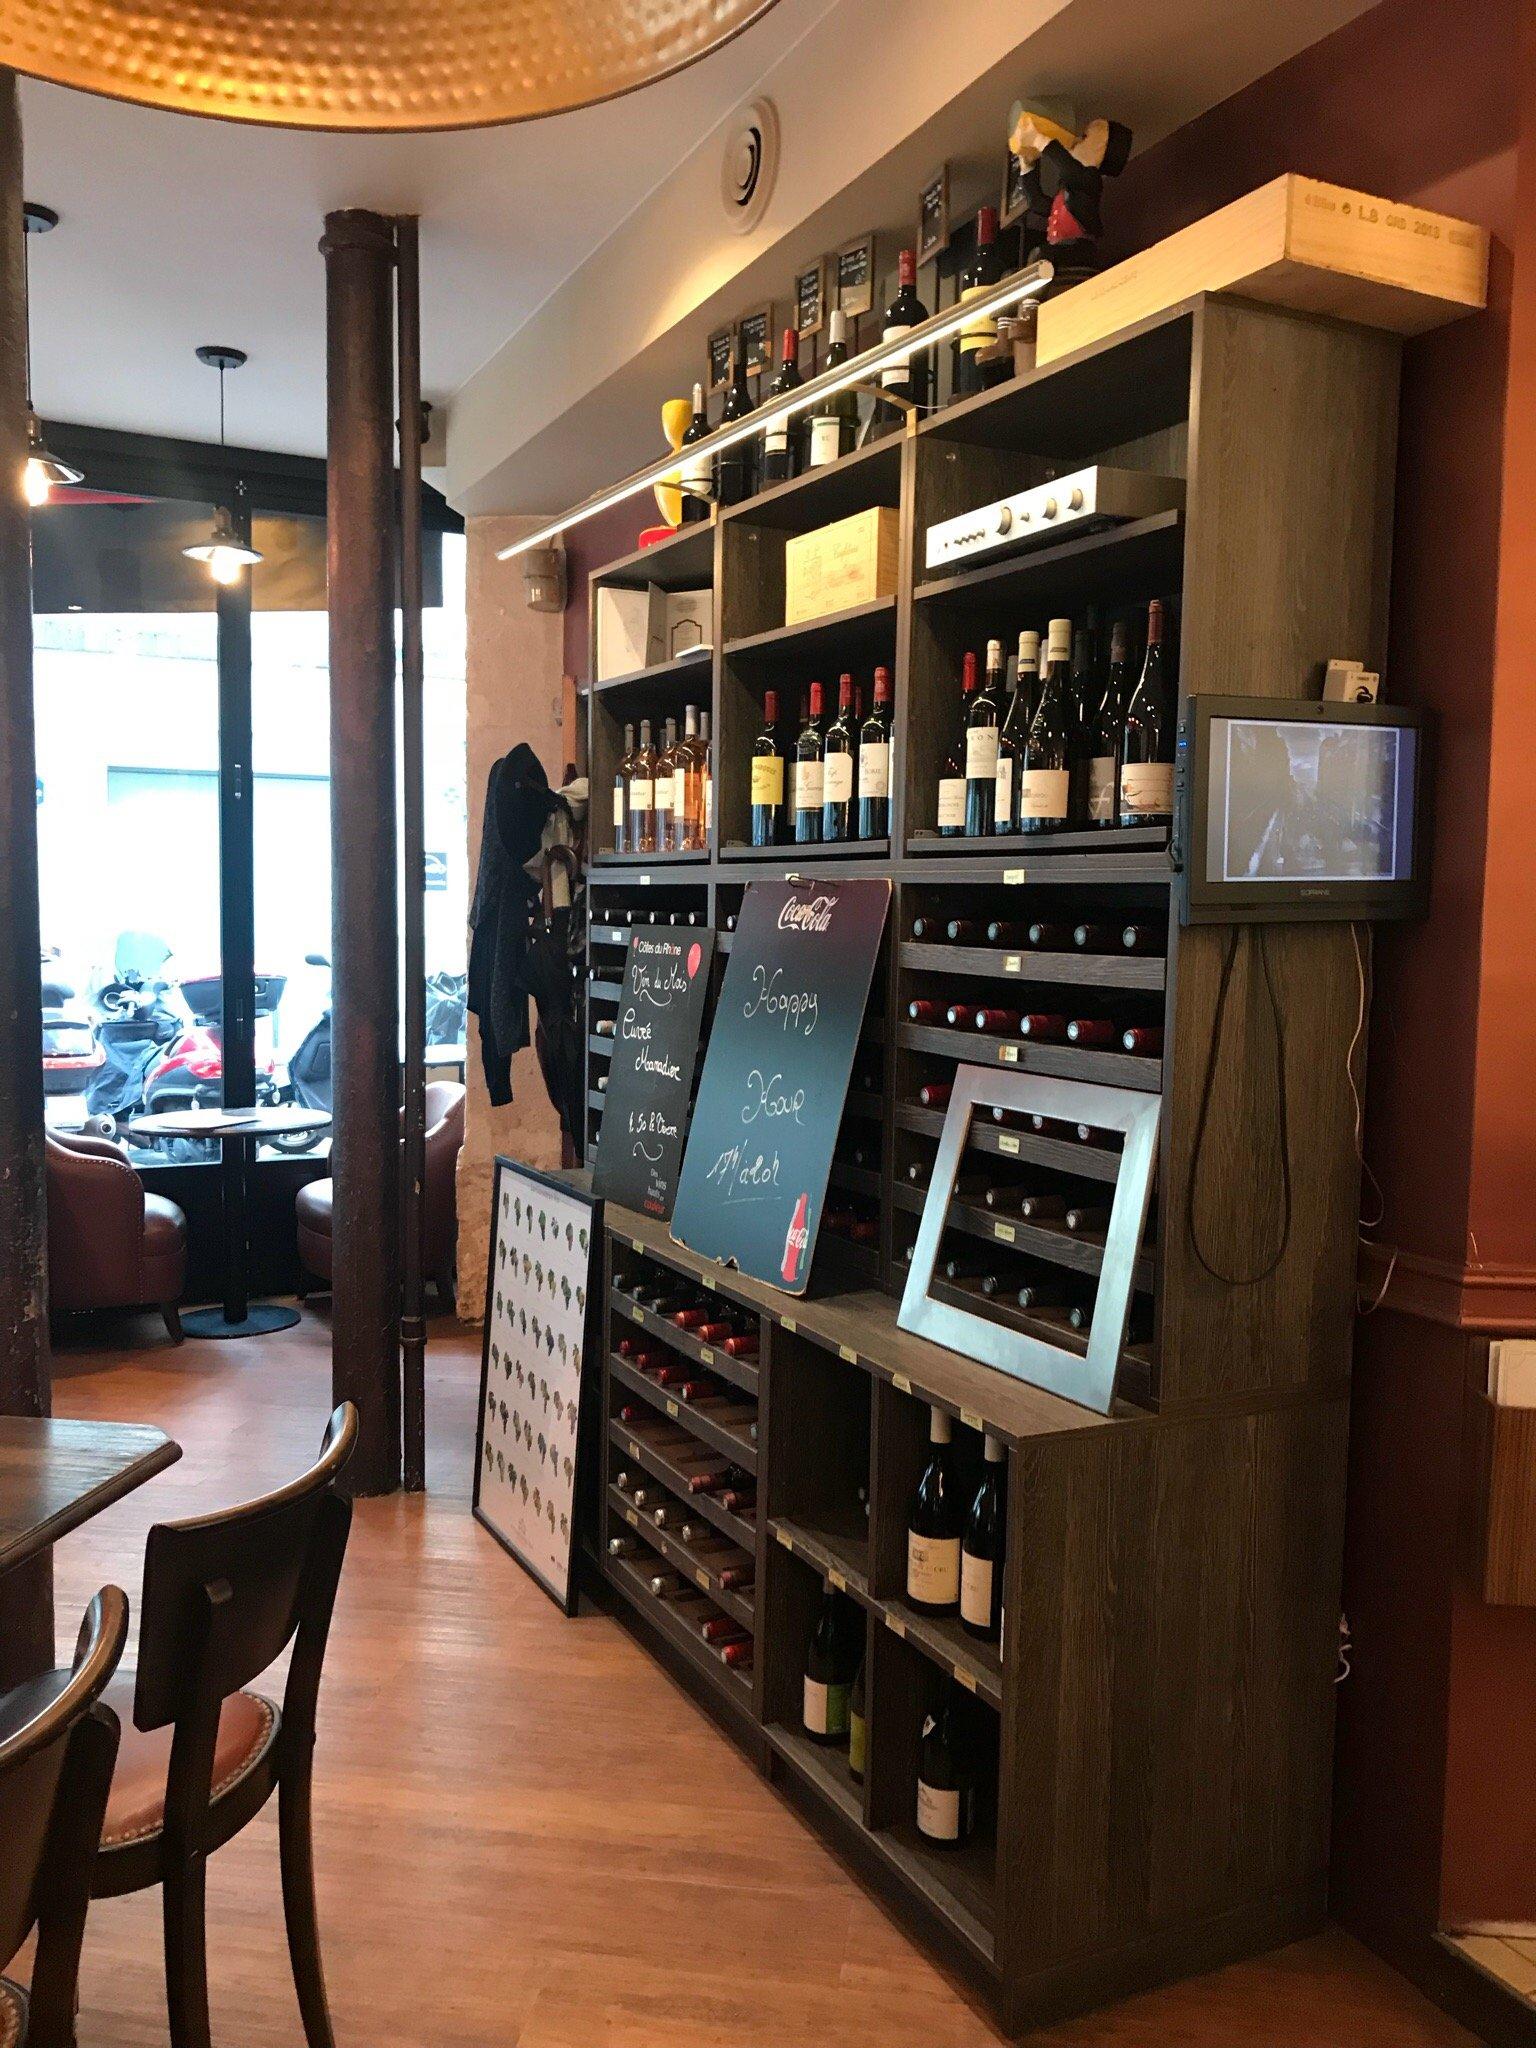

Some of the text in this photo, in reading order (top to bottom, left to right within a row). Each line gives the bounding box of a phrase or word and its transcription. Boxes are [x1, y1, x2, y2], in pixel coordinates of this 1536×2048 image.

[777, 896, 839, 932] Coca-Cola
[743, 964, 819, 1036] Happy
[741, 1069, 806, 1126] Hour
